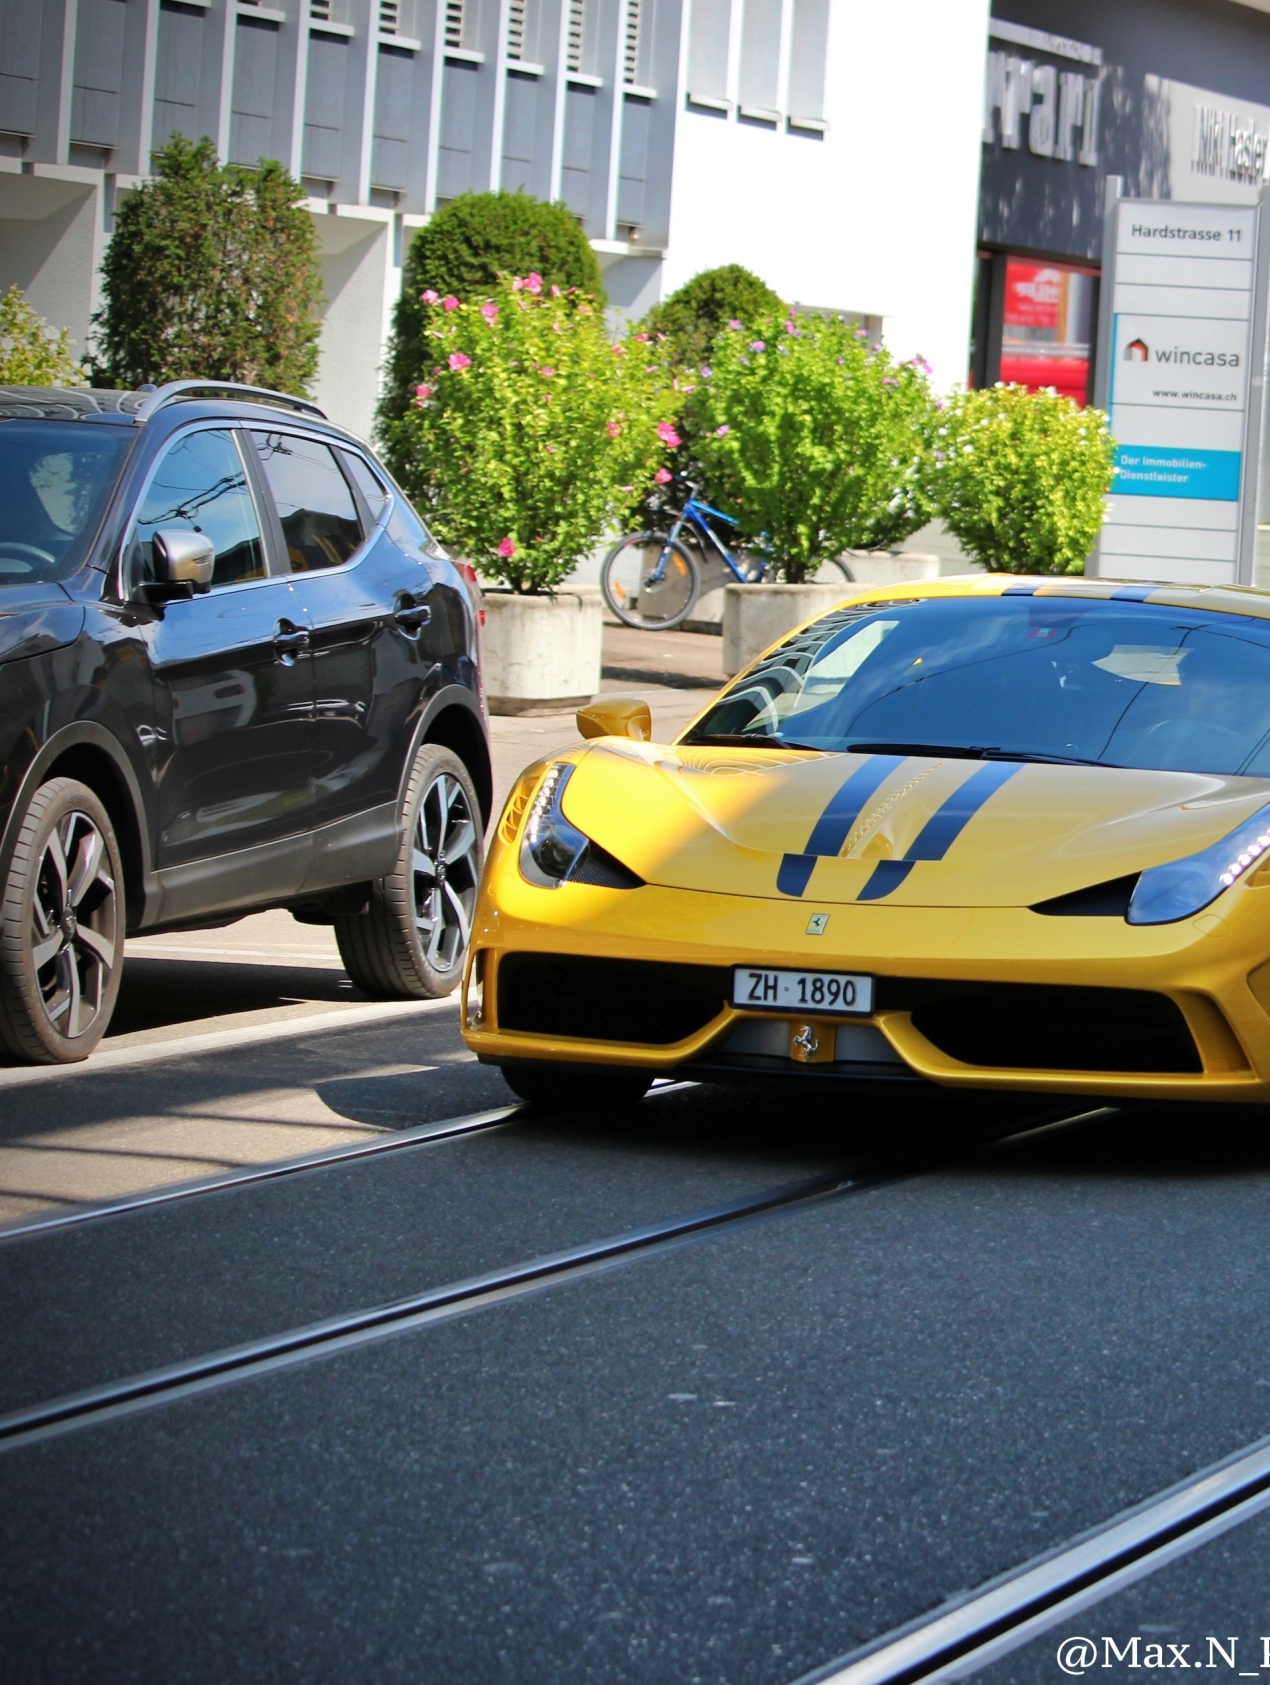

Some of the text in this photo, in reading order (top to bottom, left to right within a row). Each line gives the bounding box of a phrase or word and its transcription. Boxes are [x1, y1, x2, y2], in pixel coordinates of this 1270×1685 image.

[983, 51, 1101, 166] rrari
[1131, 224, 1242, 242] Hardstrasse 11
[1155, 346, 1240, 368] wincasa
[1152, 389, 1237, 401] www.wincasa.ch
[1120, 455, 1207, 469] Der Immobilien-
[1120, 470, 1189, 483] Dienstleister
[797, 977, 857, 1007] 1890
